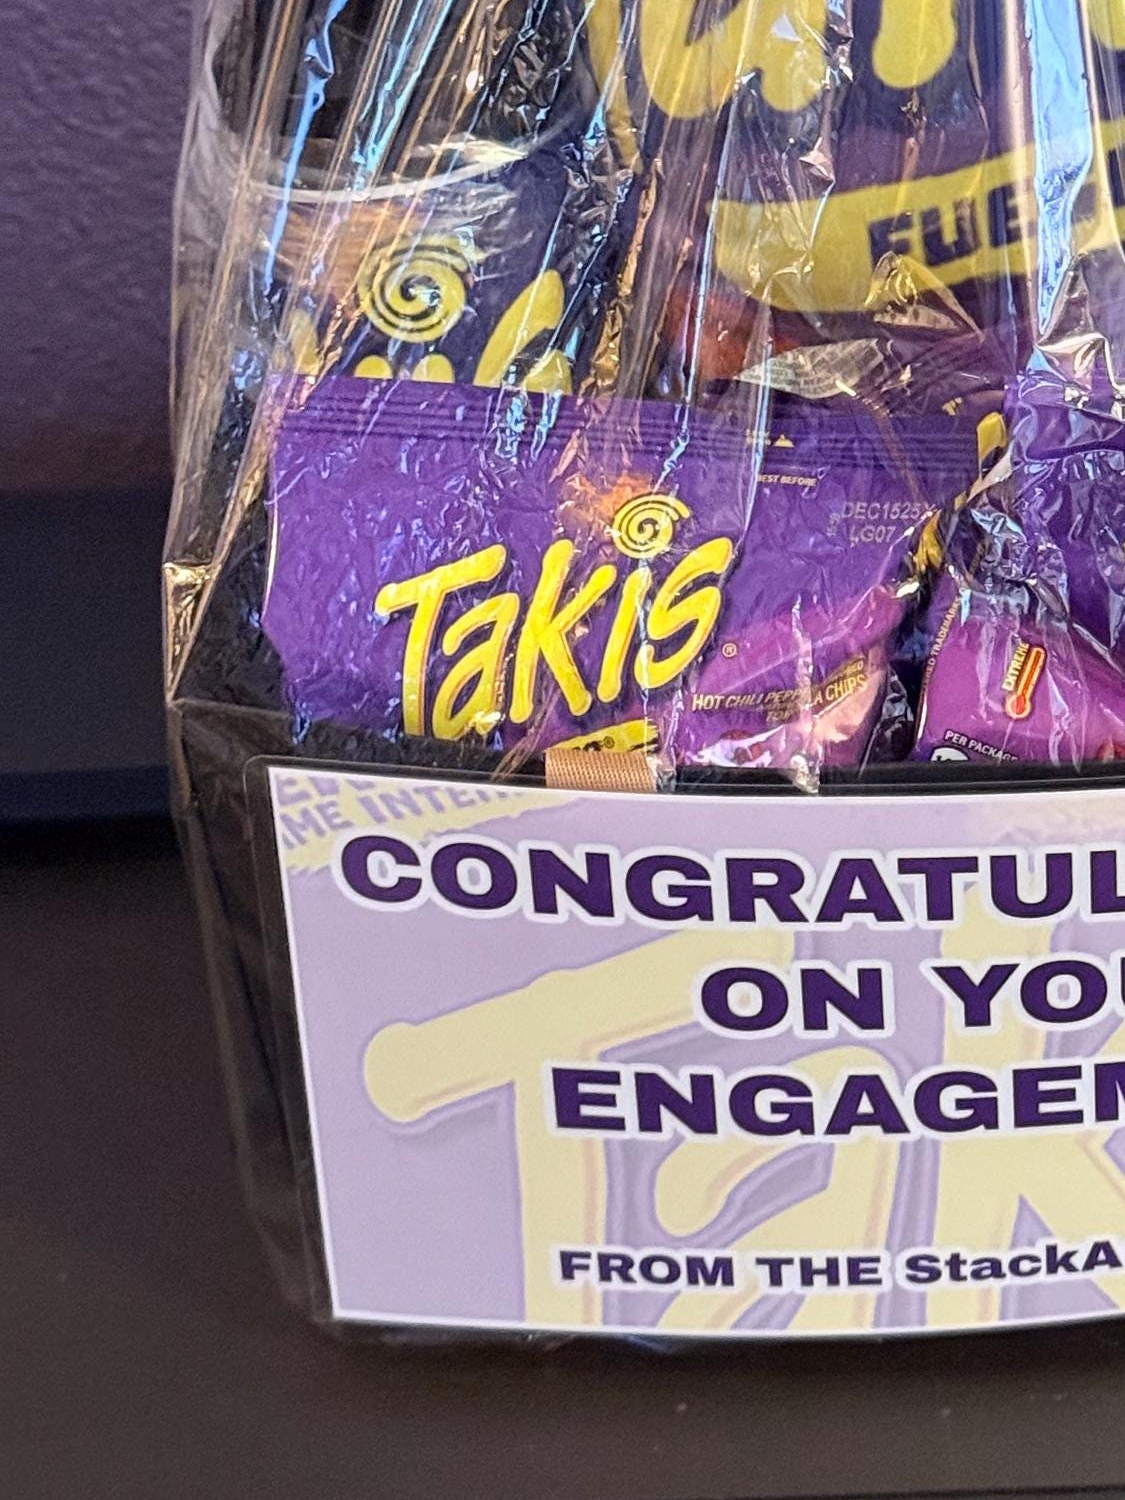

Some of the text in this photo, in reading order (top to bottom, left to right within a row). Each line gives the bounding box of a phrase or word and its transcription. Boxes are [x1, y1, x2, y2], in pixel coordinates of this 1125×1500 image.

[375, 493, 735, 739] Takis
[1001, 642, 1030, 692] EXTREME
[691, 693, 724, 711] HOT
[825, 673, 868, 701] CHIPS
[943, 730, 968, 747] PER
[700, 966, 885, 1032] ON
[559, 1250, 735, 1287] FROM
[755, 1255, 883, 1287] THE
